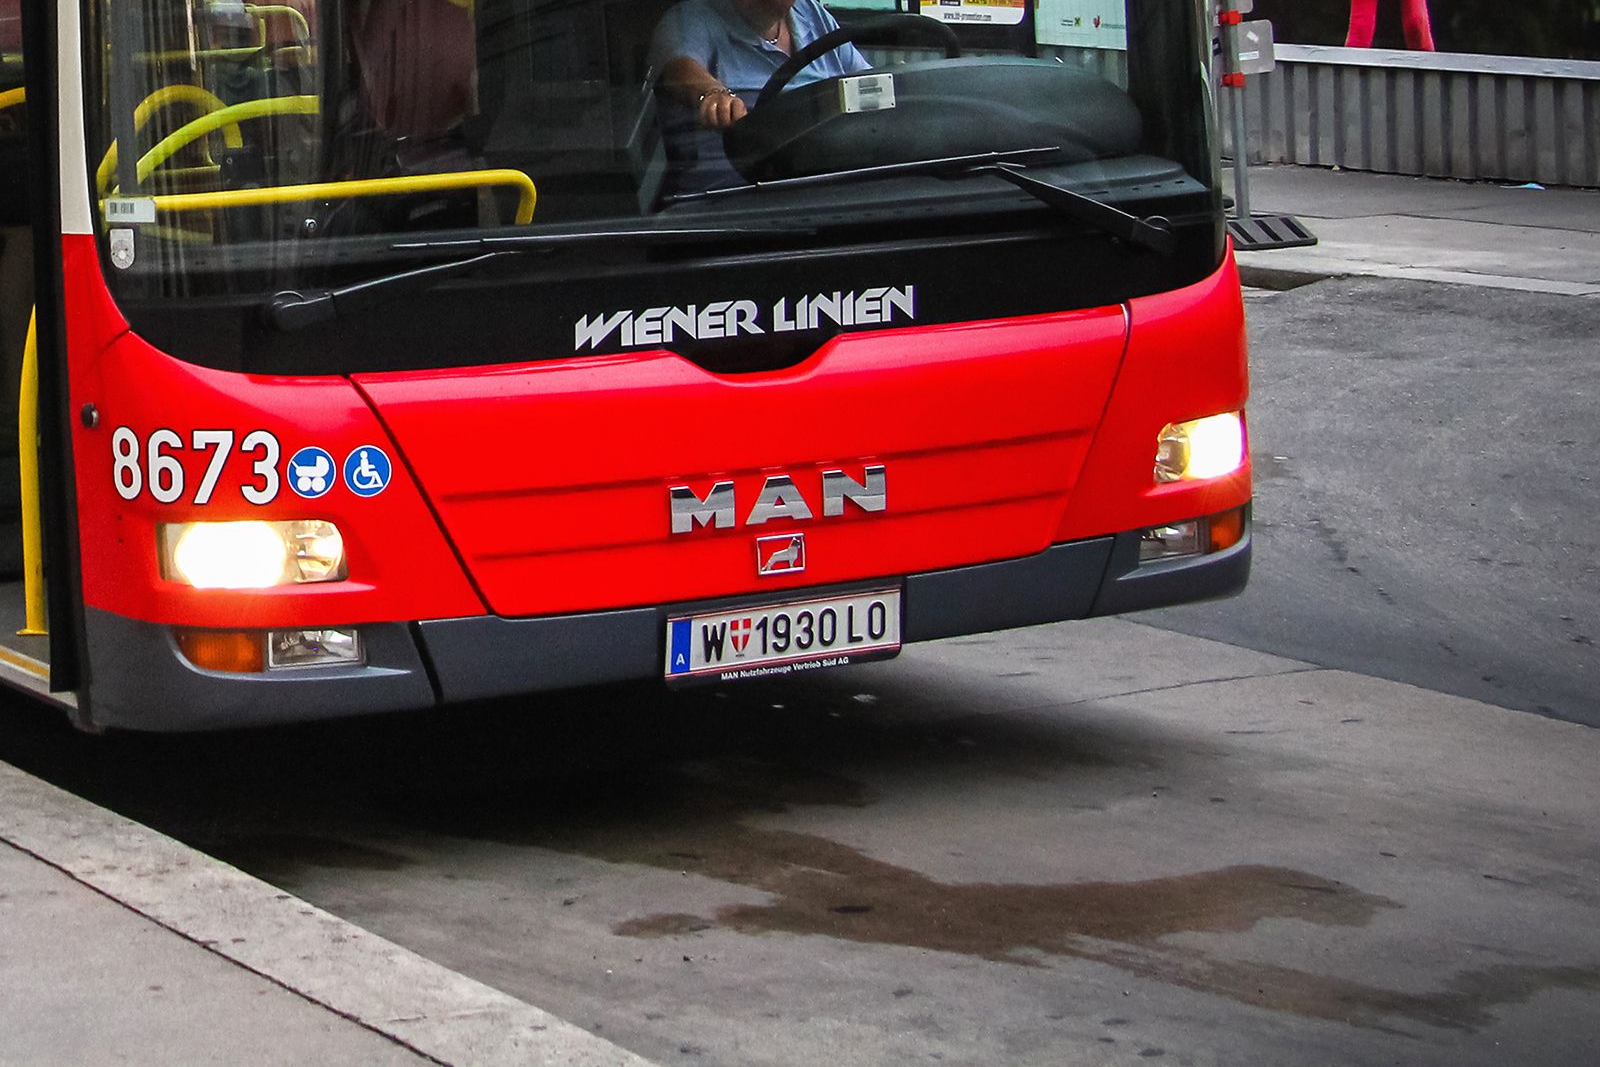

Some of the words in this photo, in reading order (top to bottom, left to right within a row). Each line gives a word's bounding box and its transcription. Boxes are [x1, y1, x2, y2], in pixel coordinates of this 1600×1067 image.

[574, 298, 764, 350] WIENER
[773, 284, 915, 333] LINIEN
[112, 427, 281, 505] 8673
[668, 464, 887, 534] MAN
[675, 653, 685, 665] A
[702, 621, 726, 663] W
[721, 671, 738, 680] MAN
[740, 664, 791, 678] Nutzfahrzeuge
[793, 660, 821, 671] Vertrieb
[822, 658, 836, 667] Süd
[838, 656, 849, 665] AG
